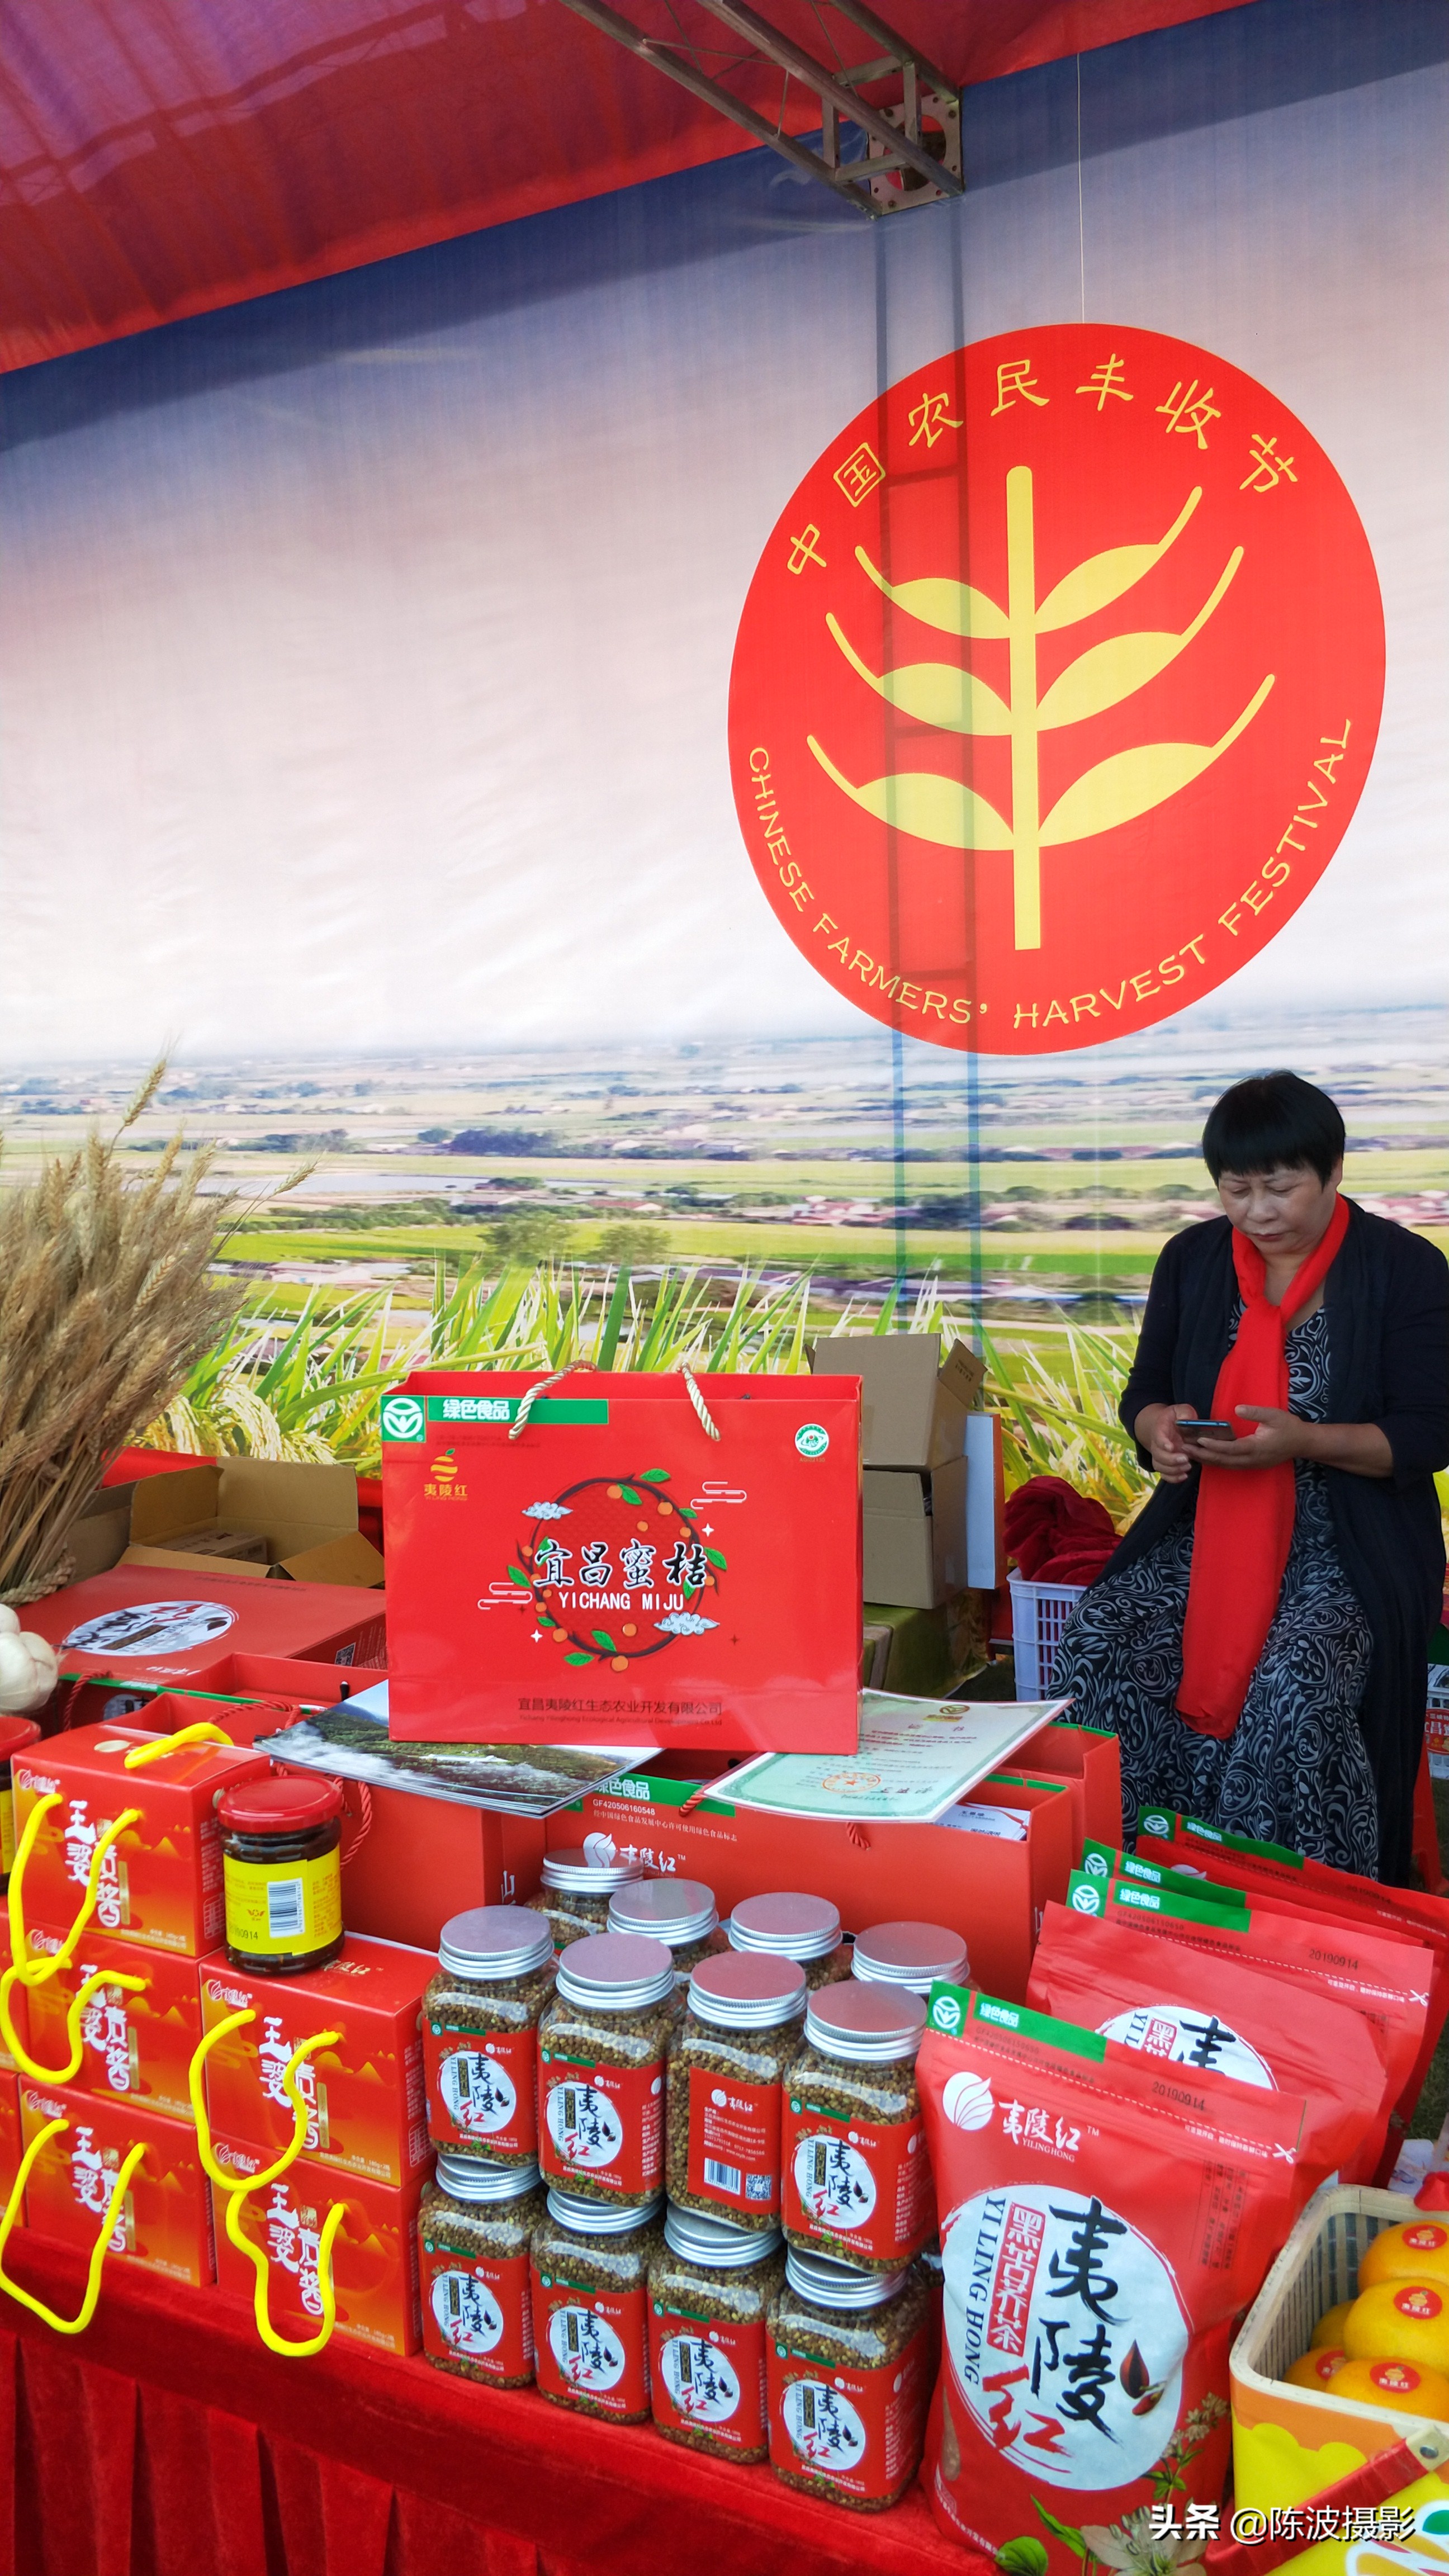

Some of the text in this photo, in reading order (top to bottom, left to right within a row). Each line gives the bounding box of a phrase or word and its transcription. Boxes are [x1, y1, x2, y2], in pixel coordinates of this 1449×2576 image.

[787, 352, 1299, 575] 中国农民丰收节
[749, 747, 815, 912] CHINESE
[1012, 934, 1206, 1029] HARVEST
[1217, 718, 1352, 936] FESTIVAL
[442, 1399, 510, 1420] 绿色食品
[424, 1483, 468, 1497] 夷陵红
[533, 1538, 708, 1589] 宜昌蜜桔
[558, 1592, 684, 1611] YICHANG MIJU
[518, 1697, 722, 1715] 宜昌夷陵红生态农业开发有限公司
[593, 1798, 655, 1816] GF420506160548
[593, 1809, 738, 1842] 经中国绿色食品发展中心许可使用绿色食品标志
[1186, 1821, 1222, 1843] 绿色食品
[1125, 1860, 1161, 1884] 绿色食品
[1120, 1888, 1160, 1910] 绿色食品
[1309, 1949, 1358, 1970] 20190914
[979, 2002, 1020, 2028] 绿色食品
[1152, 2081, 1206, 2113] 20190914
[998, 2099, 1081, 2152] 夷陵红
[1022, 2137, 1076, 2163] YILINGHONG
[964, 2195, 1006, 2385] YI LING HONG
[988, 2204, 1044, 2355] 黑苦荞茶
